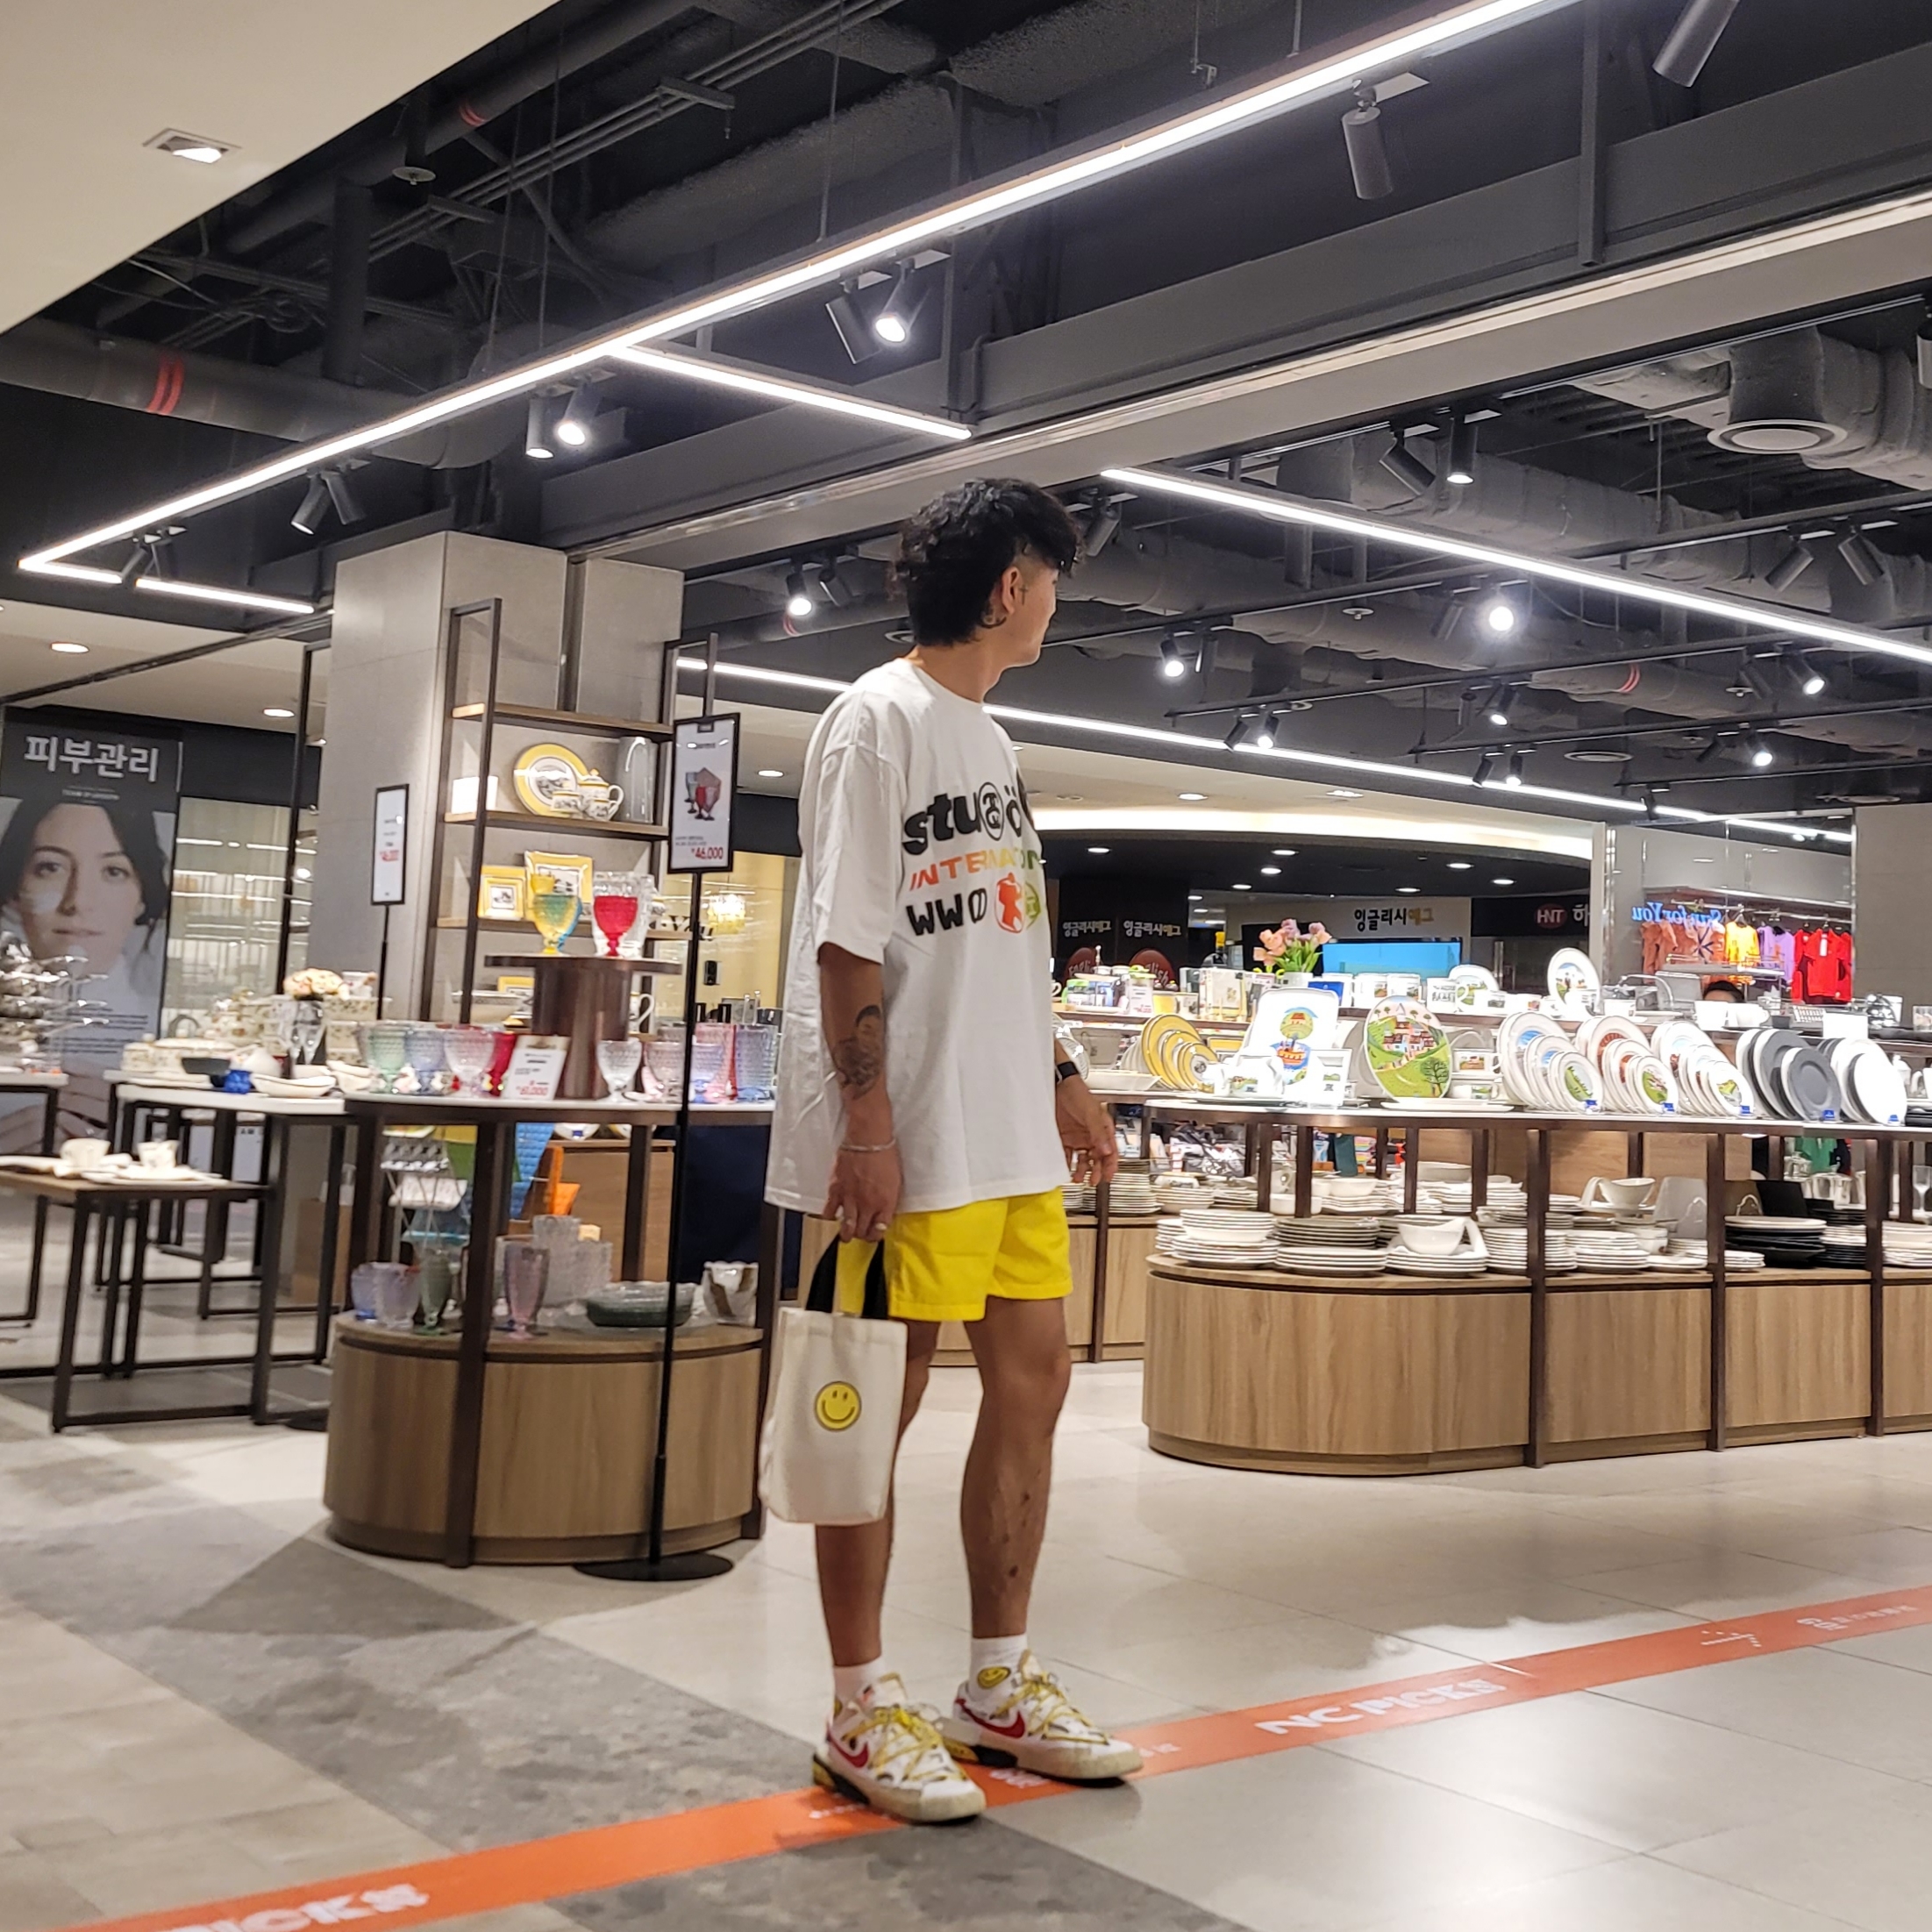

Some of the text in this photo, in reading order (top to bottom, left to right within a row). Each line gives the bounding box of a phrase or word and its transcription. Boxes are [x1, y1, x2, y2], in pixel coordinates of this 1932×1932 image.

[24, 736, 160, 782] 피부관리
[1537, 909, 1565, 923] HNT
[1254, 1678, 1507, 1735] NC PICKS
